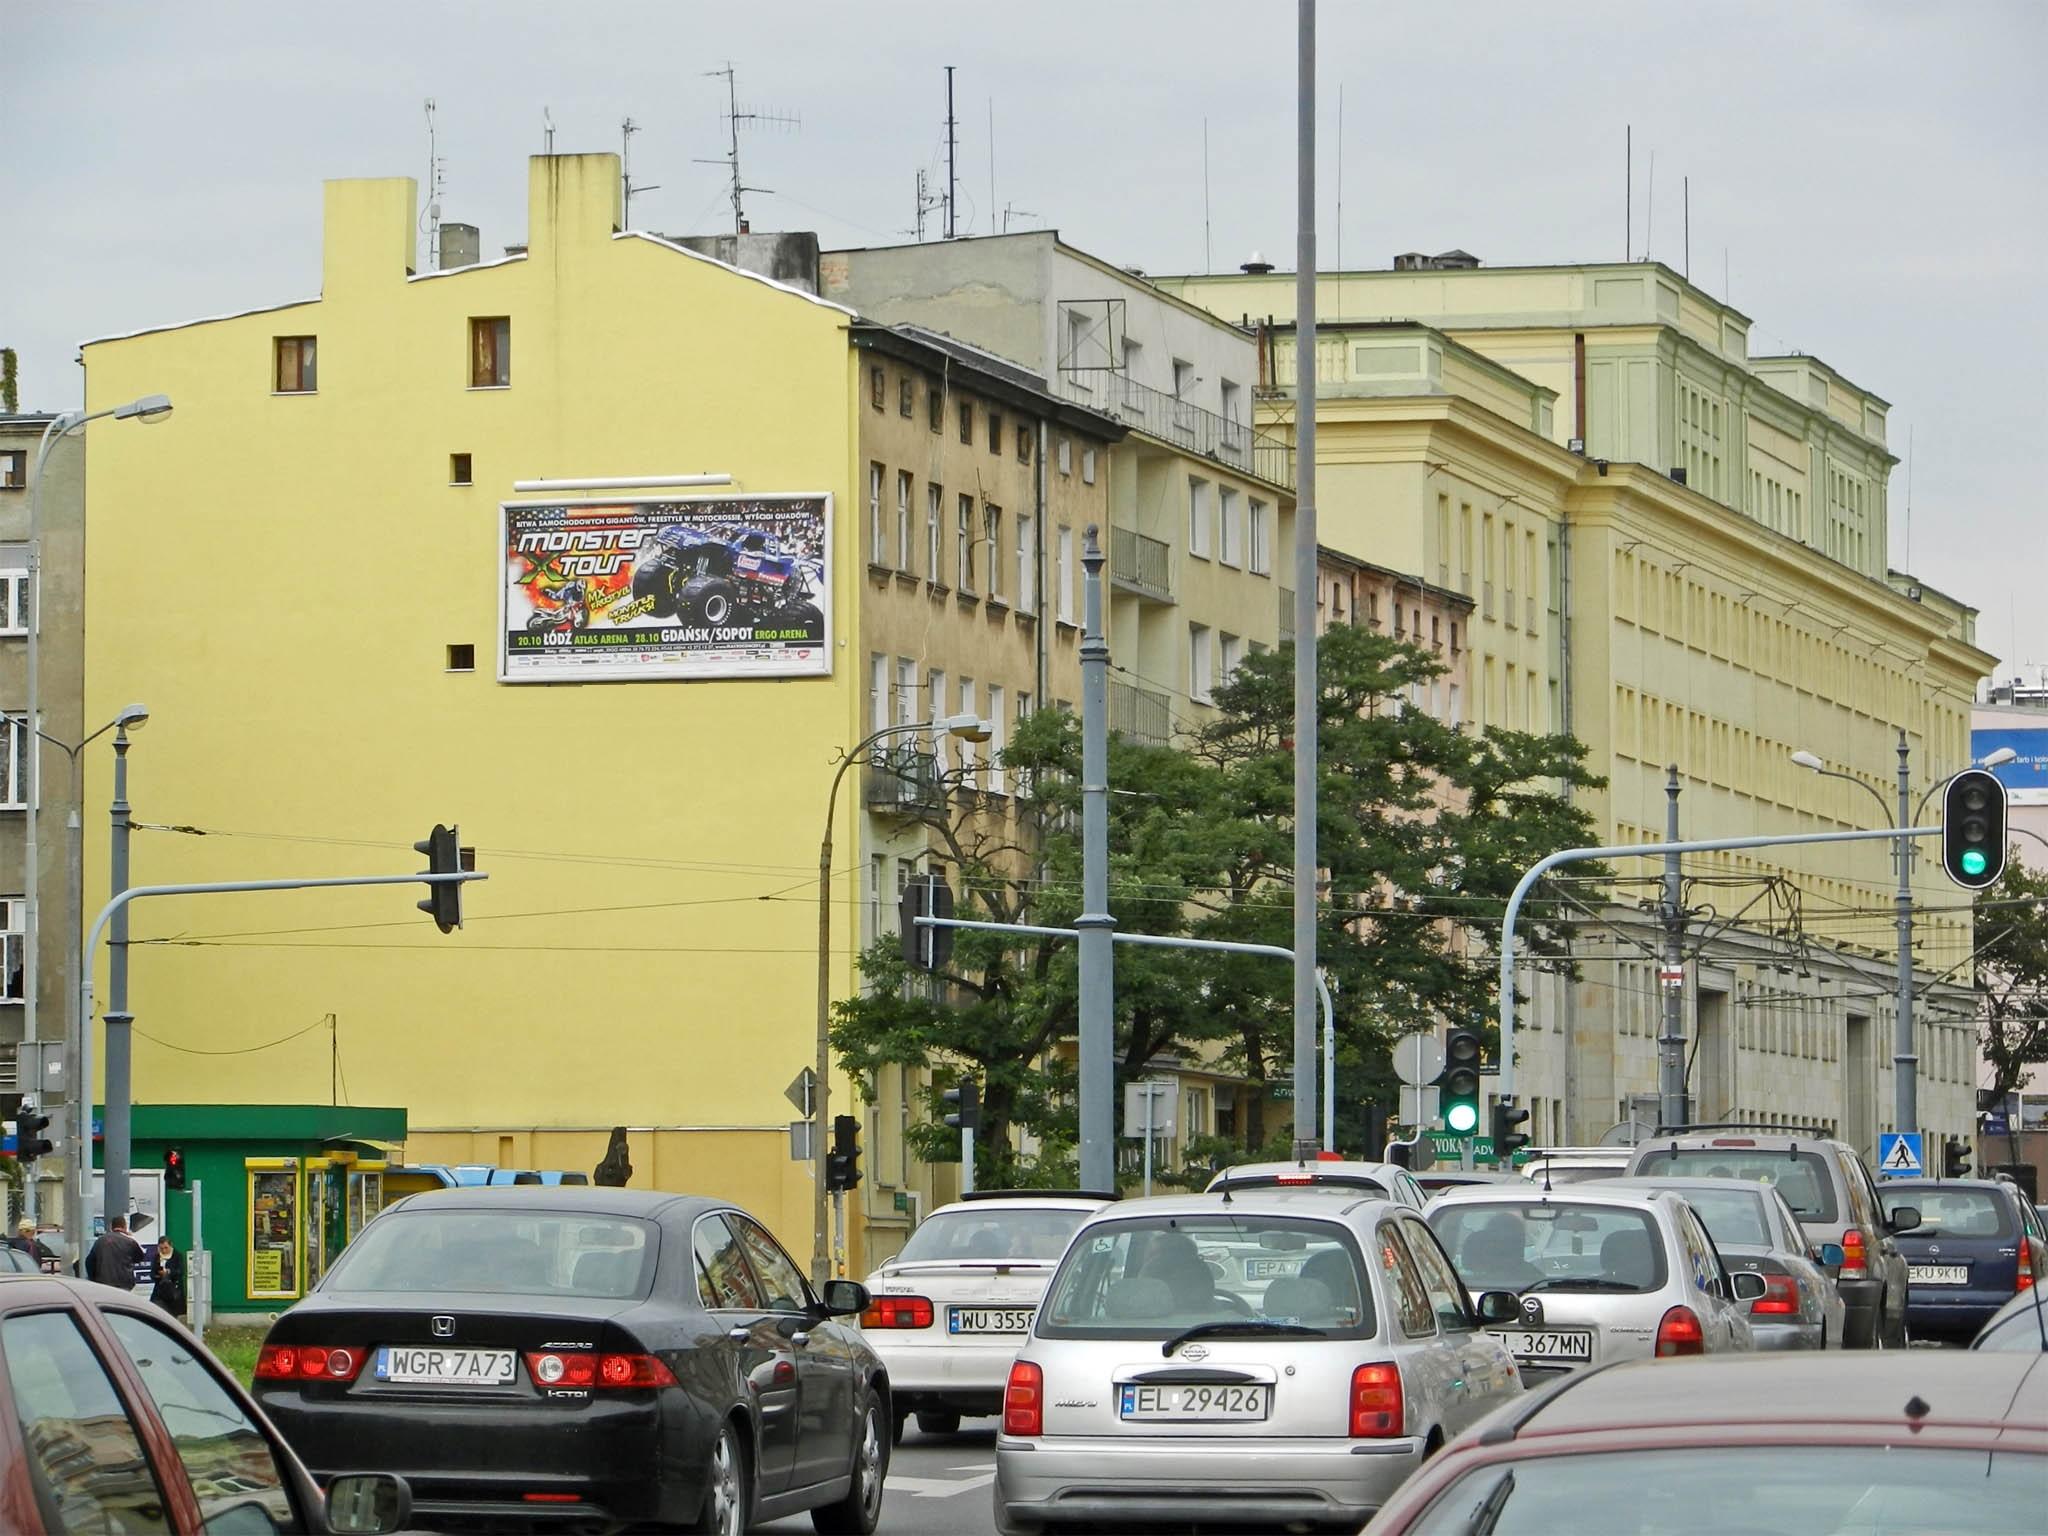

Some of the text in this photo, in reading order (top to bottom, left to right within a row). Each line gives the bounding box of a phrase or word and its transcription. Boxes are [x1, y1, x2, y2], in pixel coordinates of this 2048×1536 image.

[516, 520, 537, 528] BITWA
[538, 517, 605, 527] SAMOCHODOWYCH
[606, 514, 647, 524] GIGANTÓW,
[648, 514, 683, 523] FREESTYLE
[684, 514, 691, 522] W
[518, 625, 809, 646] 20.10 ŁÓDŹ ATLAS ARENA 28.10 GDAŃSK/SOPOT ERGO ARENA
[1431, 1137, 1464, 1153] WOKA
[1256, 1262, 1286, 1275] EPA
[962, 1312, 988, 1329] WU
[1523, 1334, 1586, 1355] 367MN
[393, 1350, 444, 1376] WGR
[453, 1351, 513, 1378] 7A73
[1138, 1387, 1170, 1412] EL
[1182, 1387, 1260, 1412] 29426
